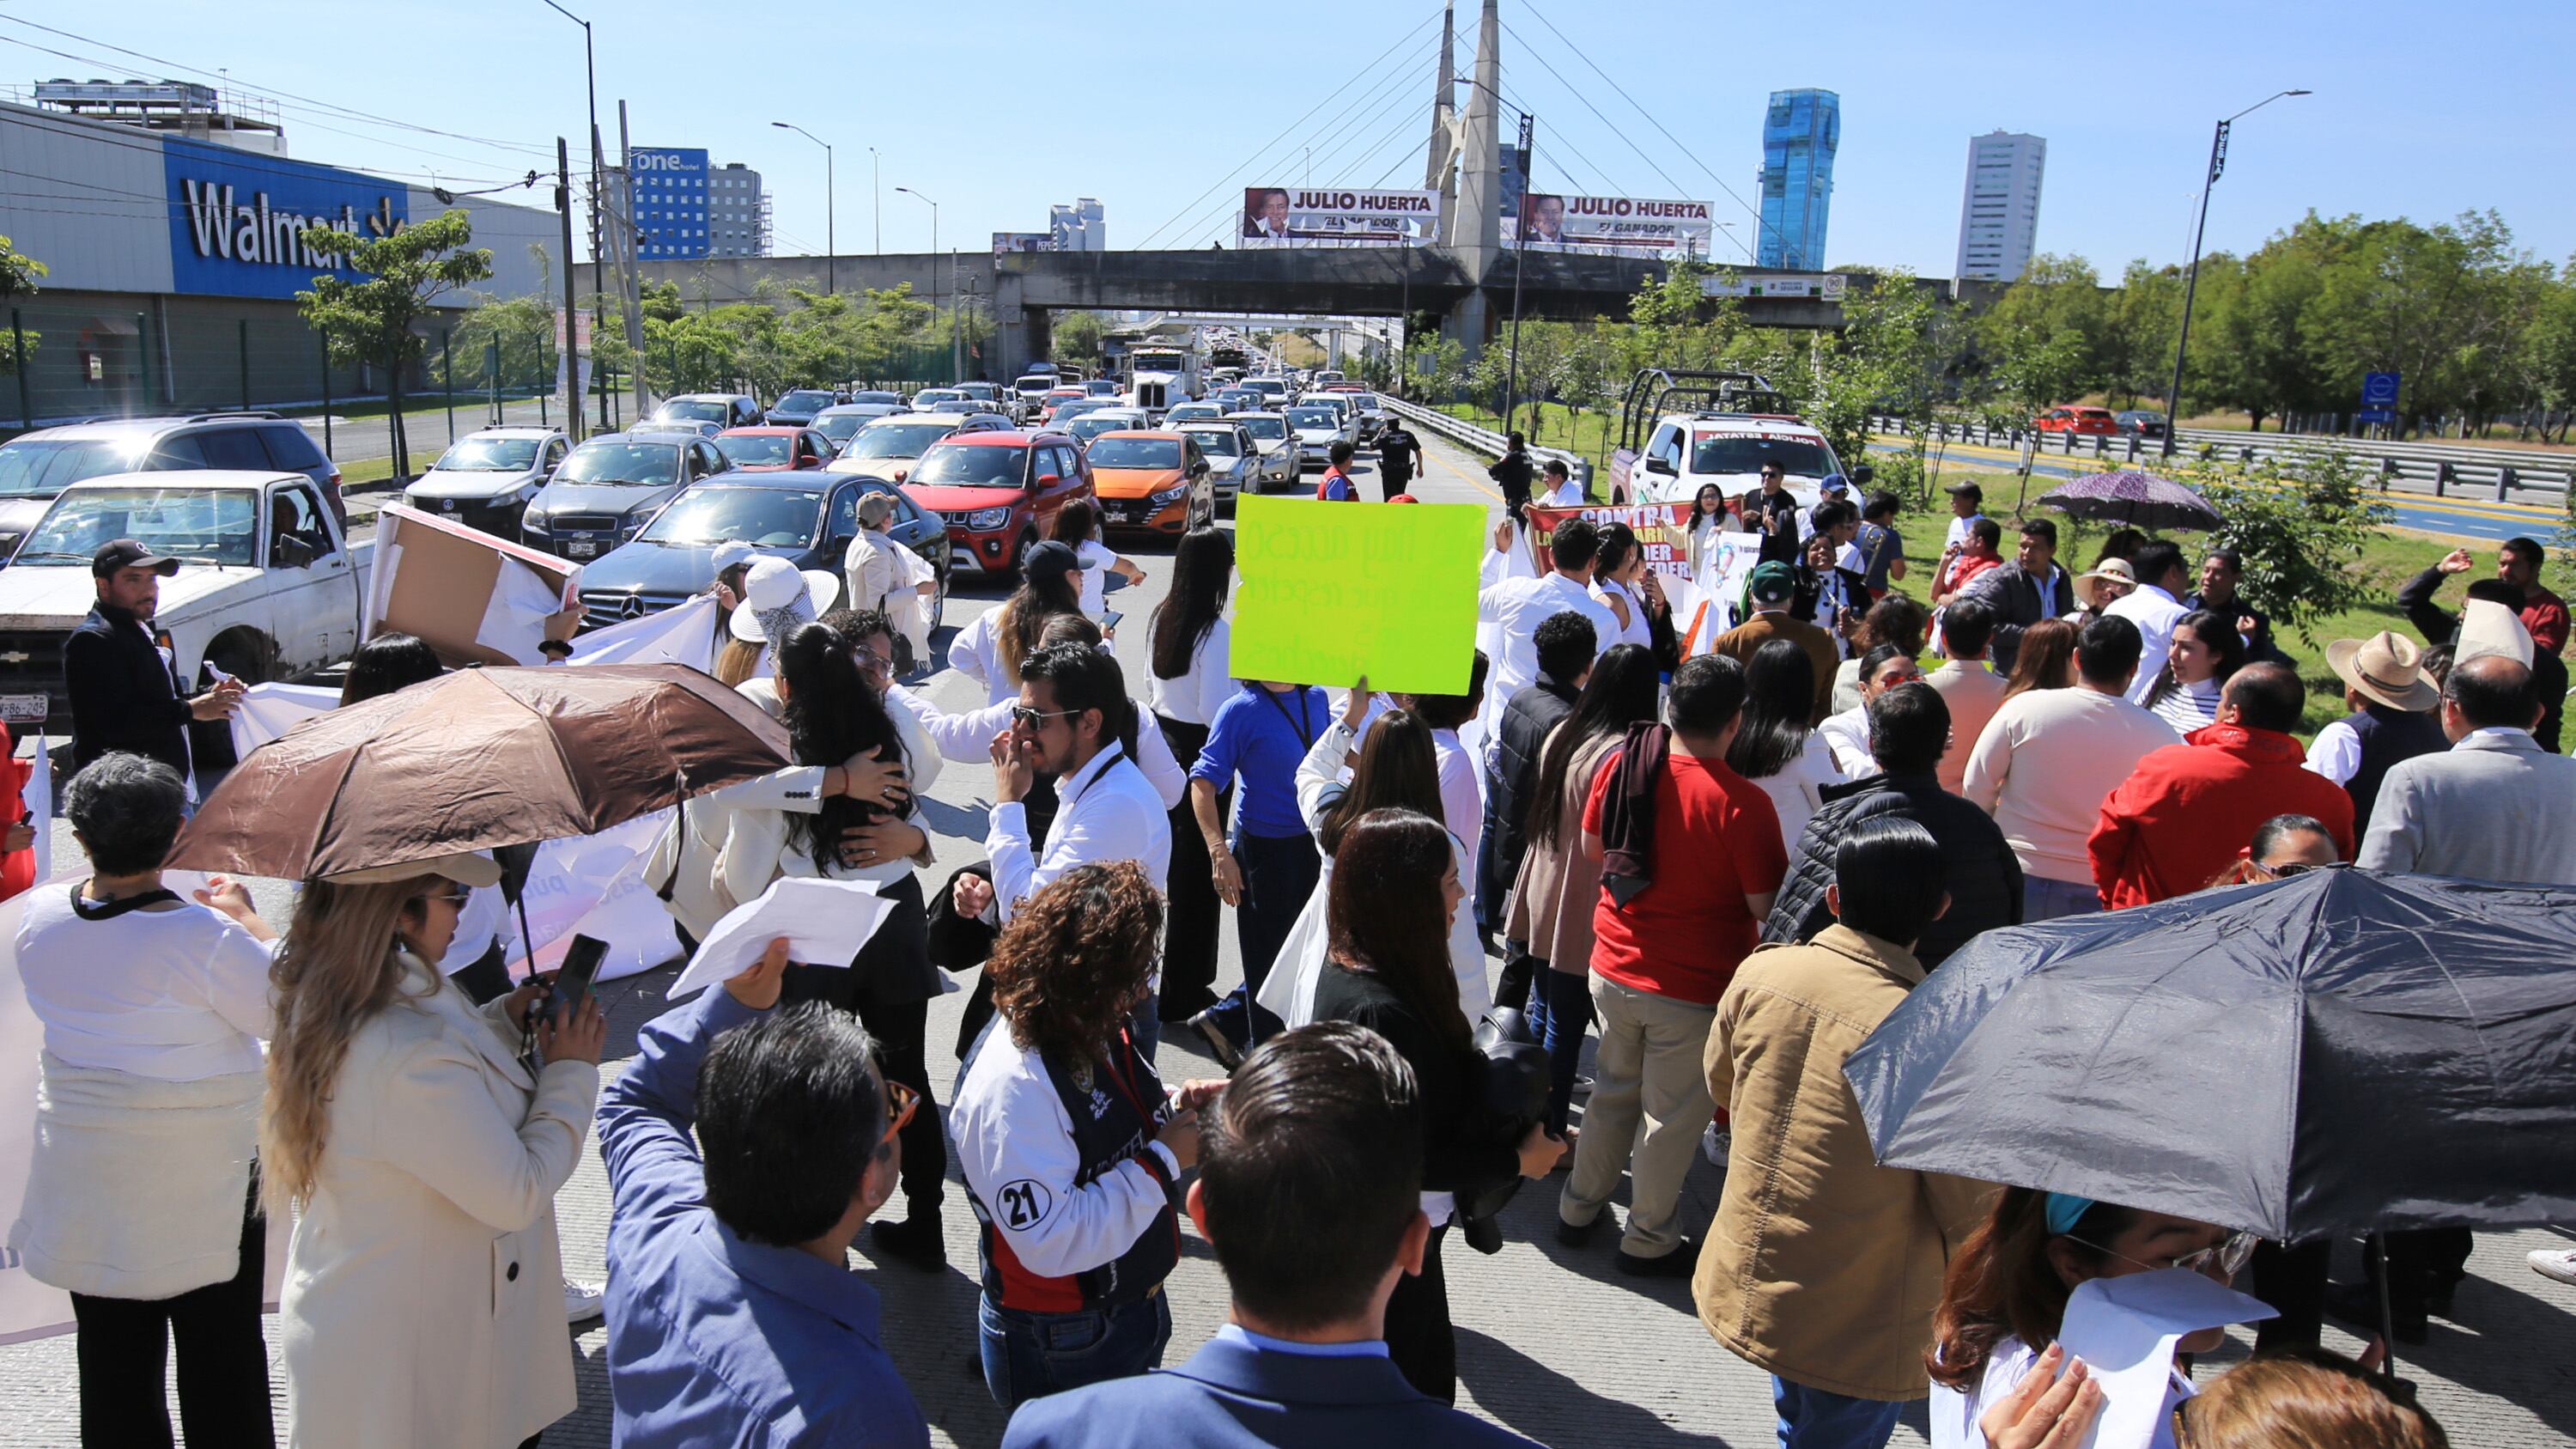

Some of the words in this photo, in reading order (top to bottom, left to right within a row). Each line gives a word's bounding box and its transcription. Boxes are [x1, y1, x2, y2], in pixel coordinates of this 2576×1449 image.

[637, 155, 680, 170] one
[1294, 192, 1357, 210] JULIO
[1360, 196, 1431, 211] HUERTA
[1568, 197, 1631, 216] JULIO
[1637, 201, 1708, 219] HUERTA
[183, 179, 359, 271] Walmart
[1614, 222, 1674, 234] GANADOR
[1003, 1182, 1040, 1227] 21
